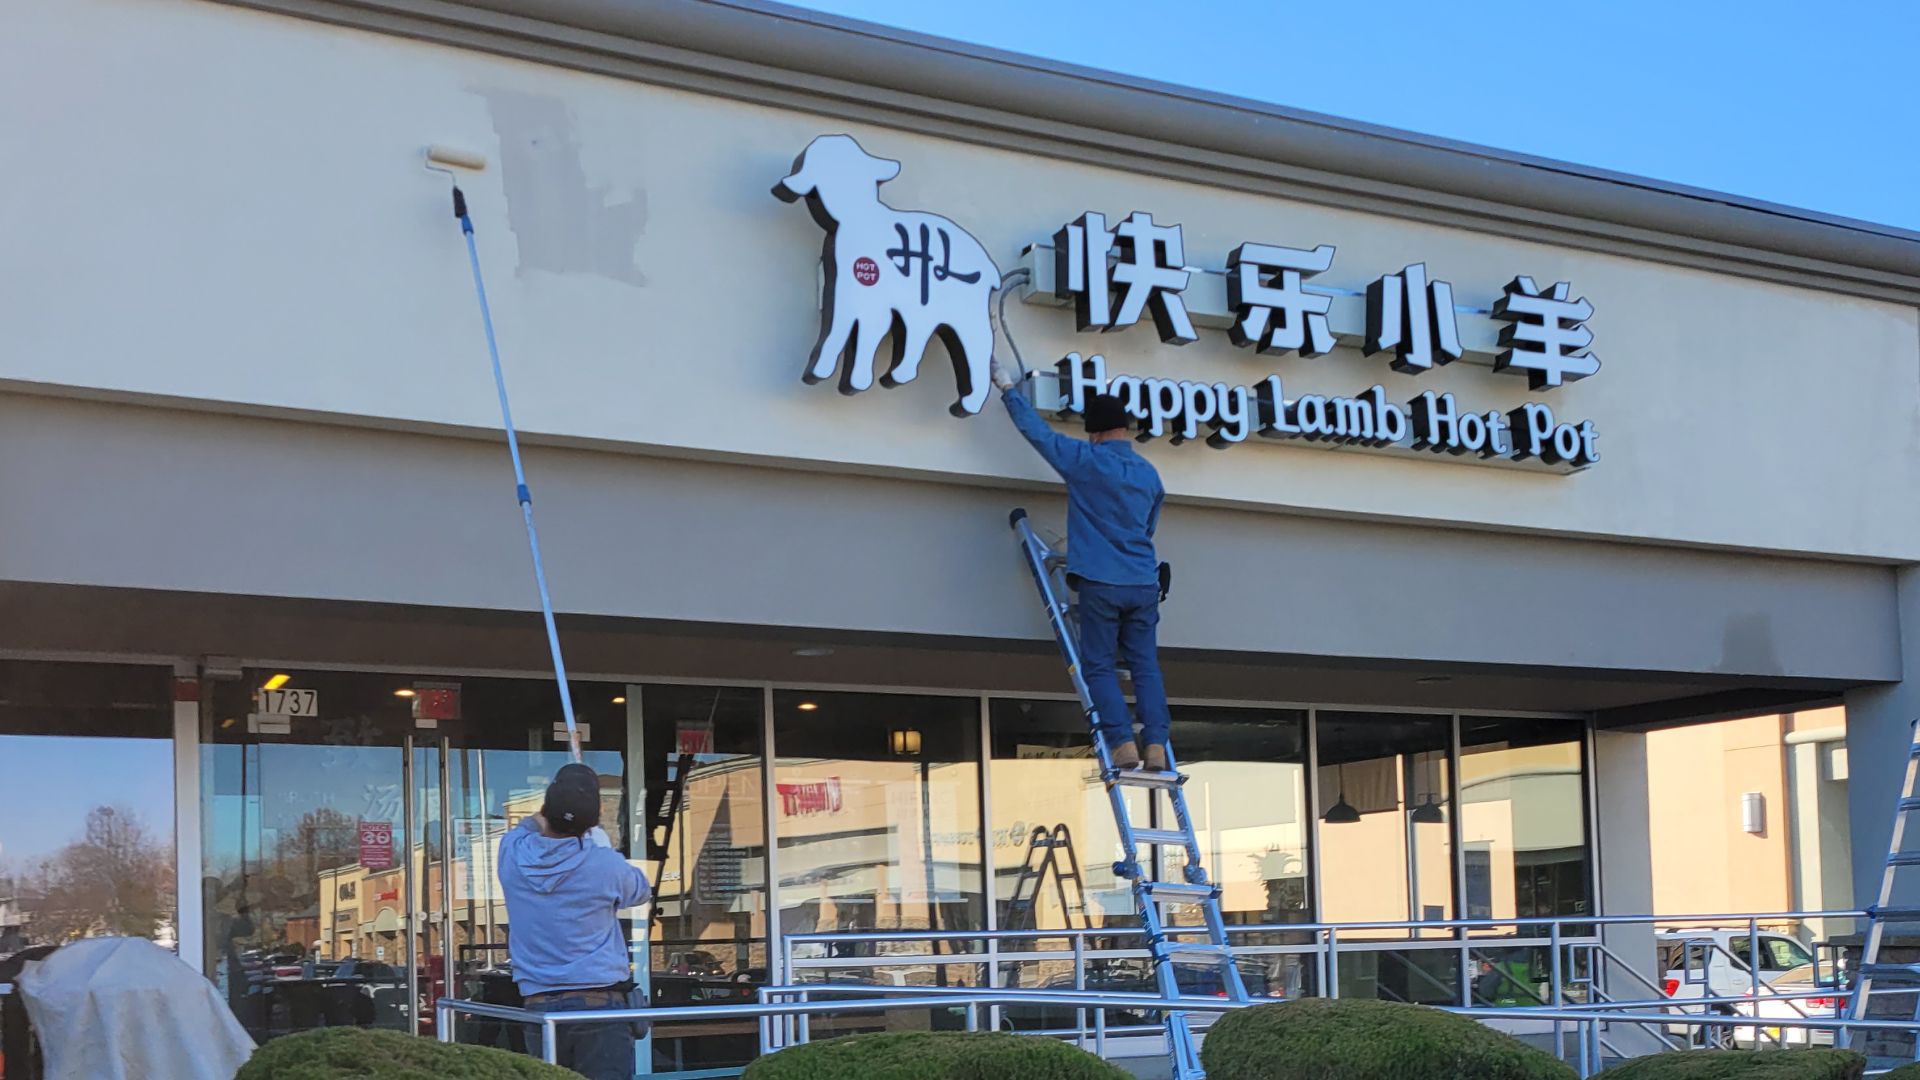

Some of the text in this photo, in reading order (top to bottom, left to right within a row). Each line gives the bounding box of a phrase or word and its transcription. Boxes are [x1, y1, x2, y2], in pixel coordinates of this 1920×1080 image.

[856, 262, 875, 271] HOT
[856, 271, 875, 281] POT
[1065, 211, 1601, 387] 快乐小羊
[1065, 352, 1600, 464] Happy Lamb Hot Pot
[262, 690, 315, 714] 1737
